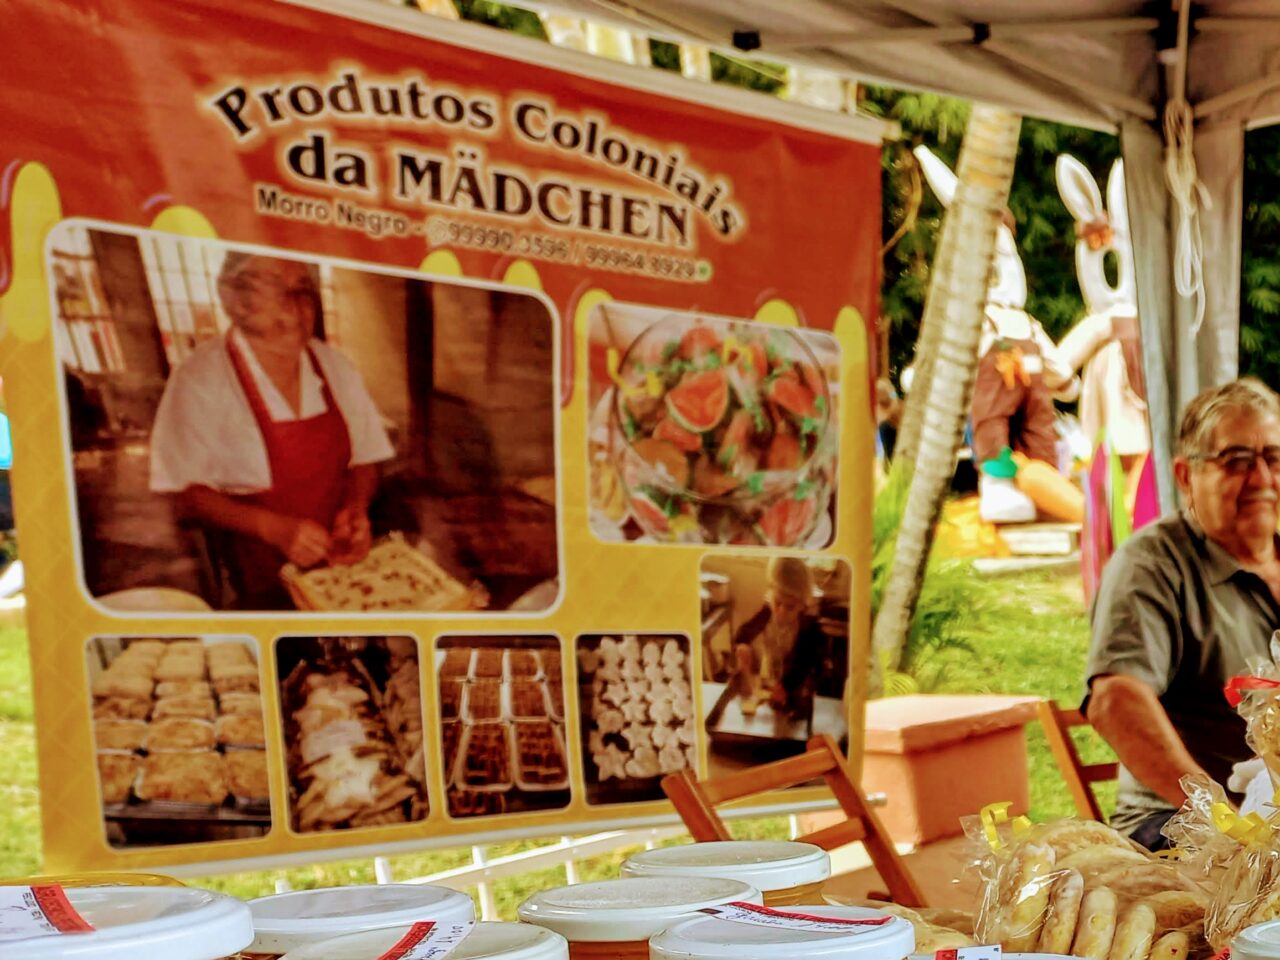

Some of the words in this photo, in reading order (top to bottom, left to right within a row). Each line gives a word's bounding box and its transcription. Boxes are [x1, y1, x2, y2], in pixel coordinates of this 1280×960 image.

[214, 72, 495, 137] Produtos
[515, 103, 741, 236] Coloniais
[287, 135, 367, 189] da
[399, 149, 693, 247] MÄDCHEN
[257, 188, 329, 220] Morro
[337, 202, 406, 235] Negro
